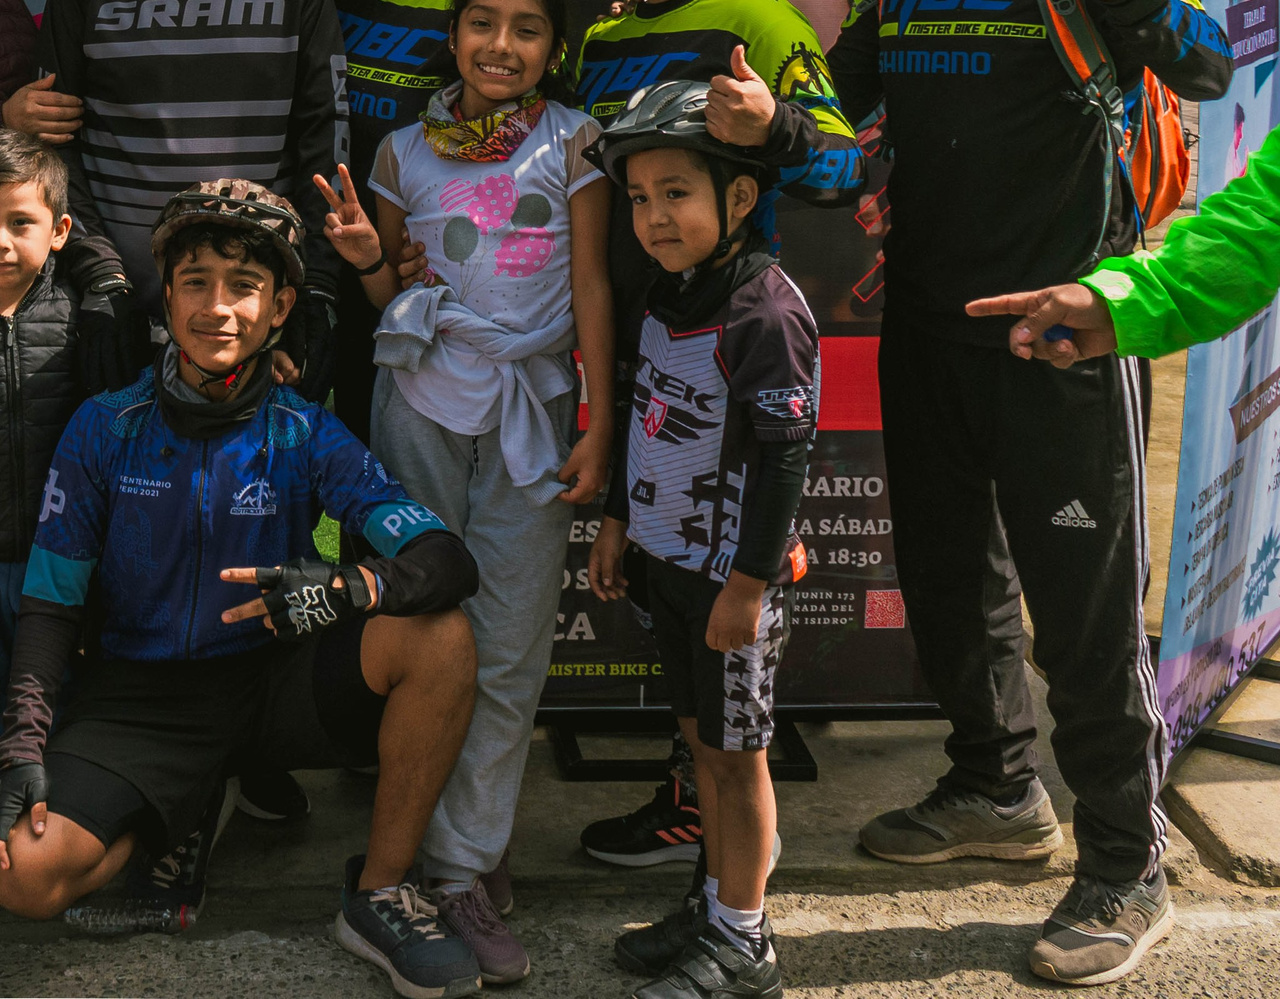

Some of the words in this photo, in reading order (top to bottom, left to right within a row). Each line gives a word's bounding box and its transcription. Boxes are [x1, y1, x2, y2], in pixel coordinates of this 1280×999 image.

[908, 22, 952, 35] MISTER
[954, 22, 981, 34] BIKE
[983, 22, 1045, 38] CHOSICA
[372, 70, 394, 83] BIKE
[140, 488, 159, 497] 2021
[1051, 515, 1097, 529] adidas
[827, 548, 882, 568] 18:30
[795, 591, 833, 600] JUNIN
[837, 592, 855, 601] 173
[831, 604, 855, 612] DEL
[609, 663, 647, 676] BIKE
